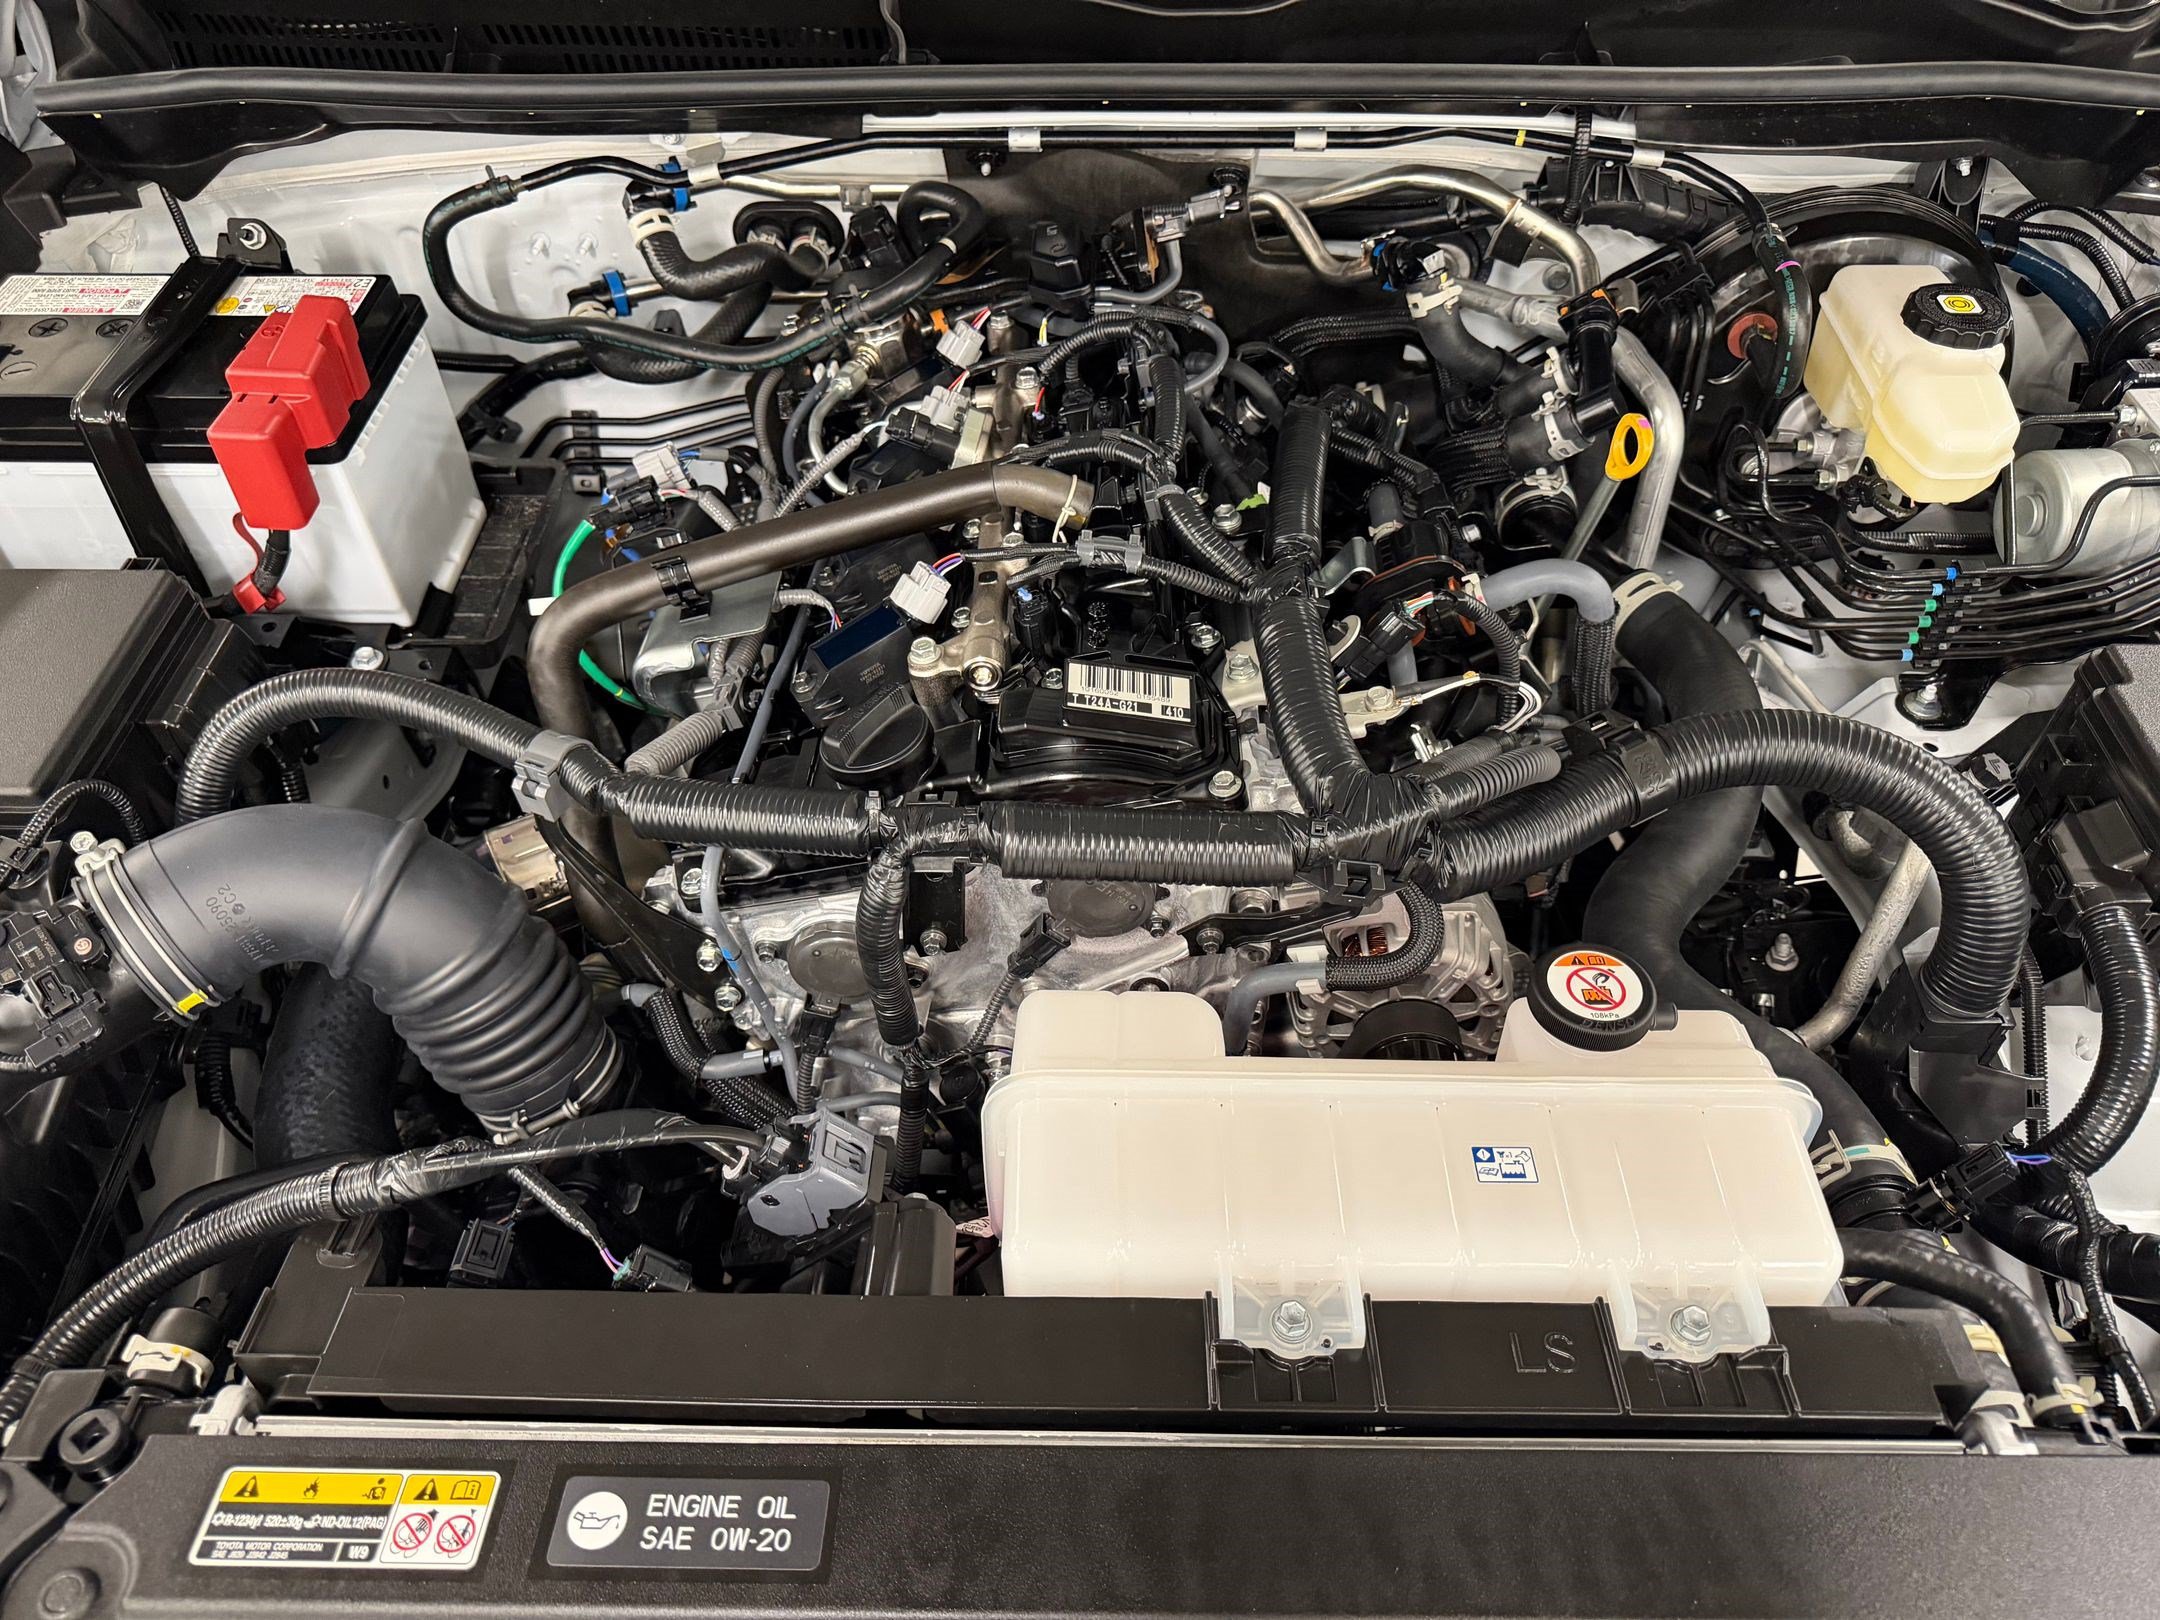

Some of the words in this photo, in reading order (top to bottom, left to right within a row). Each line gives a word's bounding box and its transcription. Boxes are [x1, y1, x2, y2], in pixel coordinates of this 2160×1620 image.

[1072, 693, 1079, 705] T
[1084, 694, 1138, 712] T24A-G21
[1165, 706, 1184, 718] 410
[1509, 1332, 1577, 1373] LS
[646, 1493, 742, 1519] ENGINE
[757, 1495, 797, 1519] OIL
[215, 1541, 245, 1550] TOYOTA
[245, 1541, 272, 1551] MOTOR
[273, 1541, 324, 1552] CORPORATION
[639, 1525, 696, 1551] SAE
[710, 1526, 792, 1552] 0W-20
[348, 1545, 370, 1560] W9
